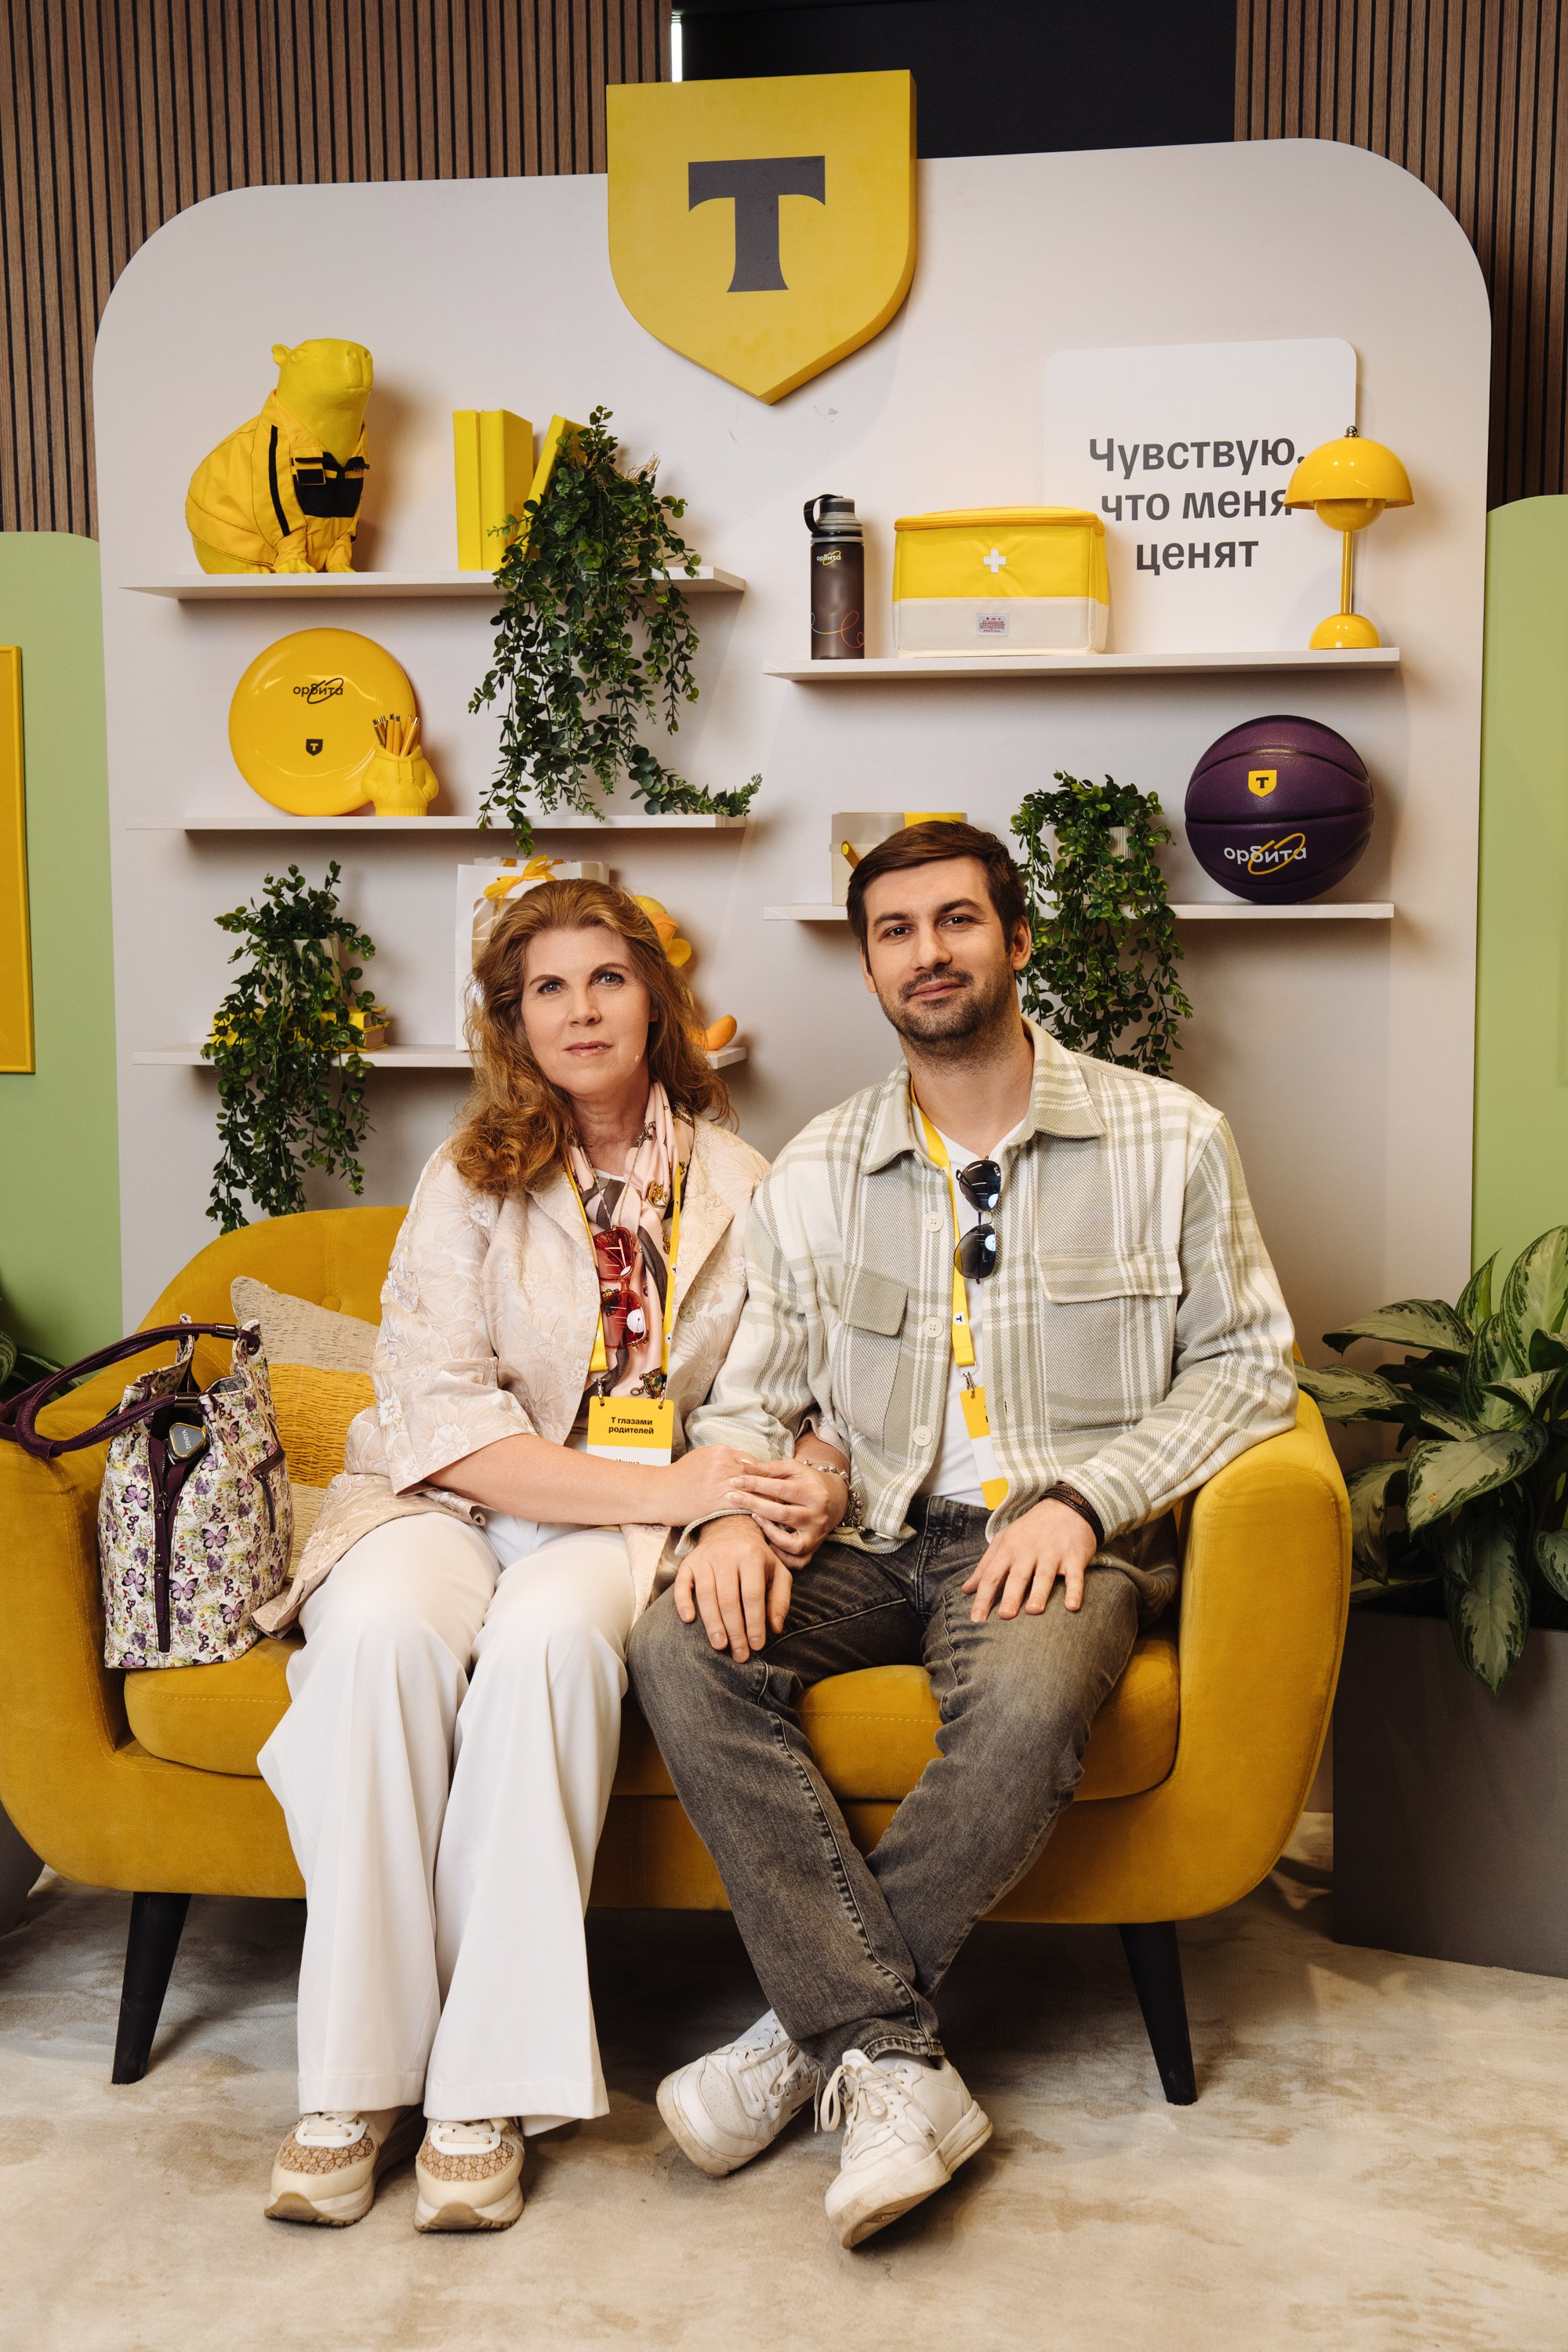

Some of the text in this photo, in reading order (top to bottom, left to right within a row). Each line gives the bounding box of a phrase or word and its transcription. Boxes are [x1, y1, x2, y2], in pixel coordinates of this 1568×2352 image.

[1101, 489, 1293, 521] что меня
[816, 554, 842, 563] орбита
[1136, 540, 1259, 576] ценят
[292, 683, 344, 698] орбита
[1223, 845, 1308, 865] орбита
[608, 1426, 654, 1435] родителей
